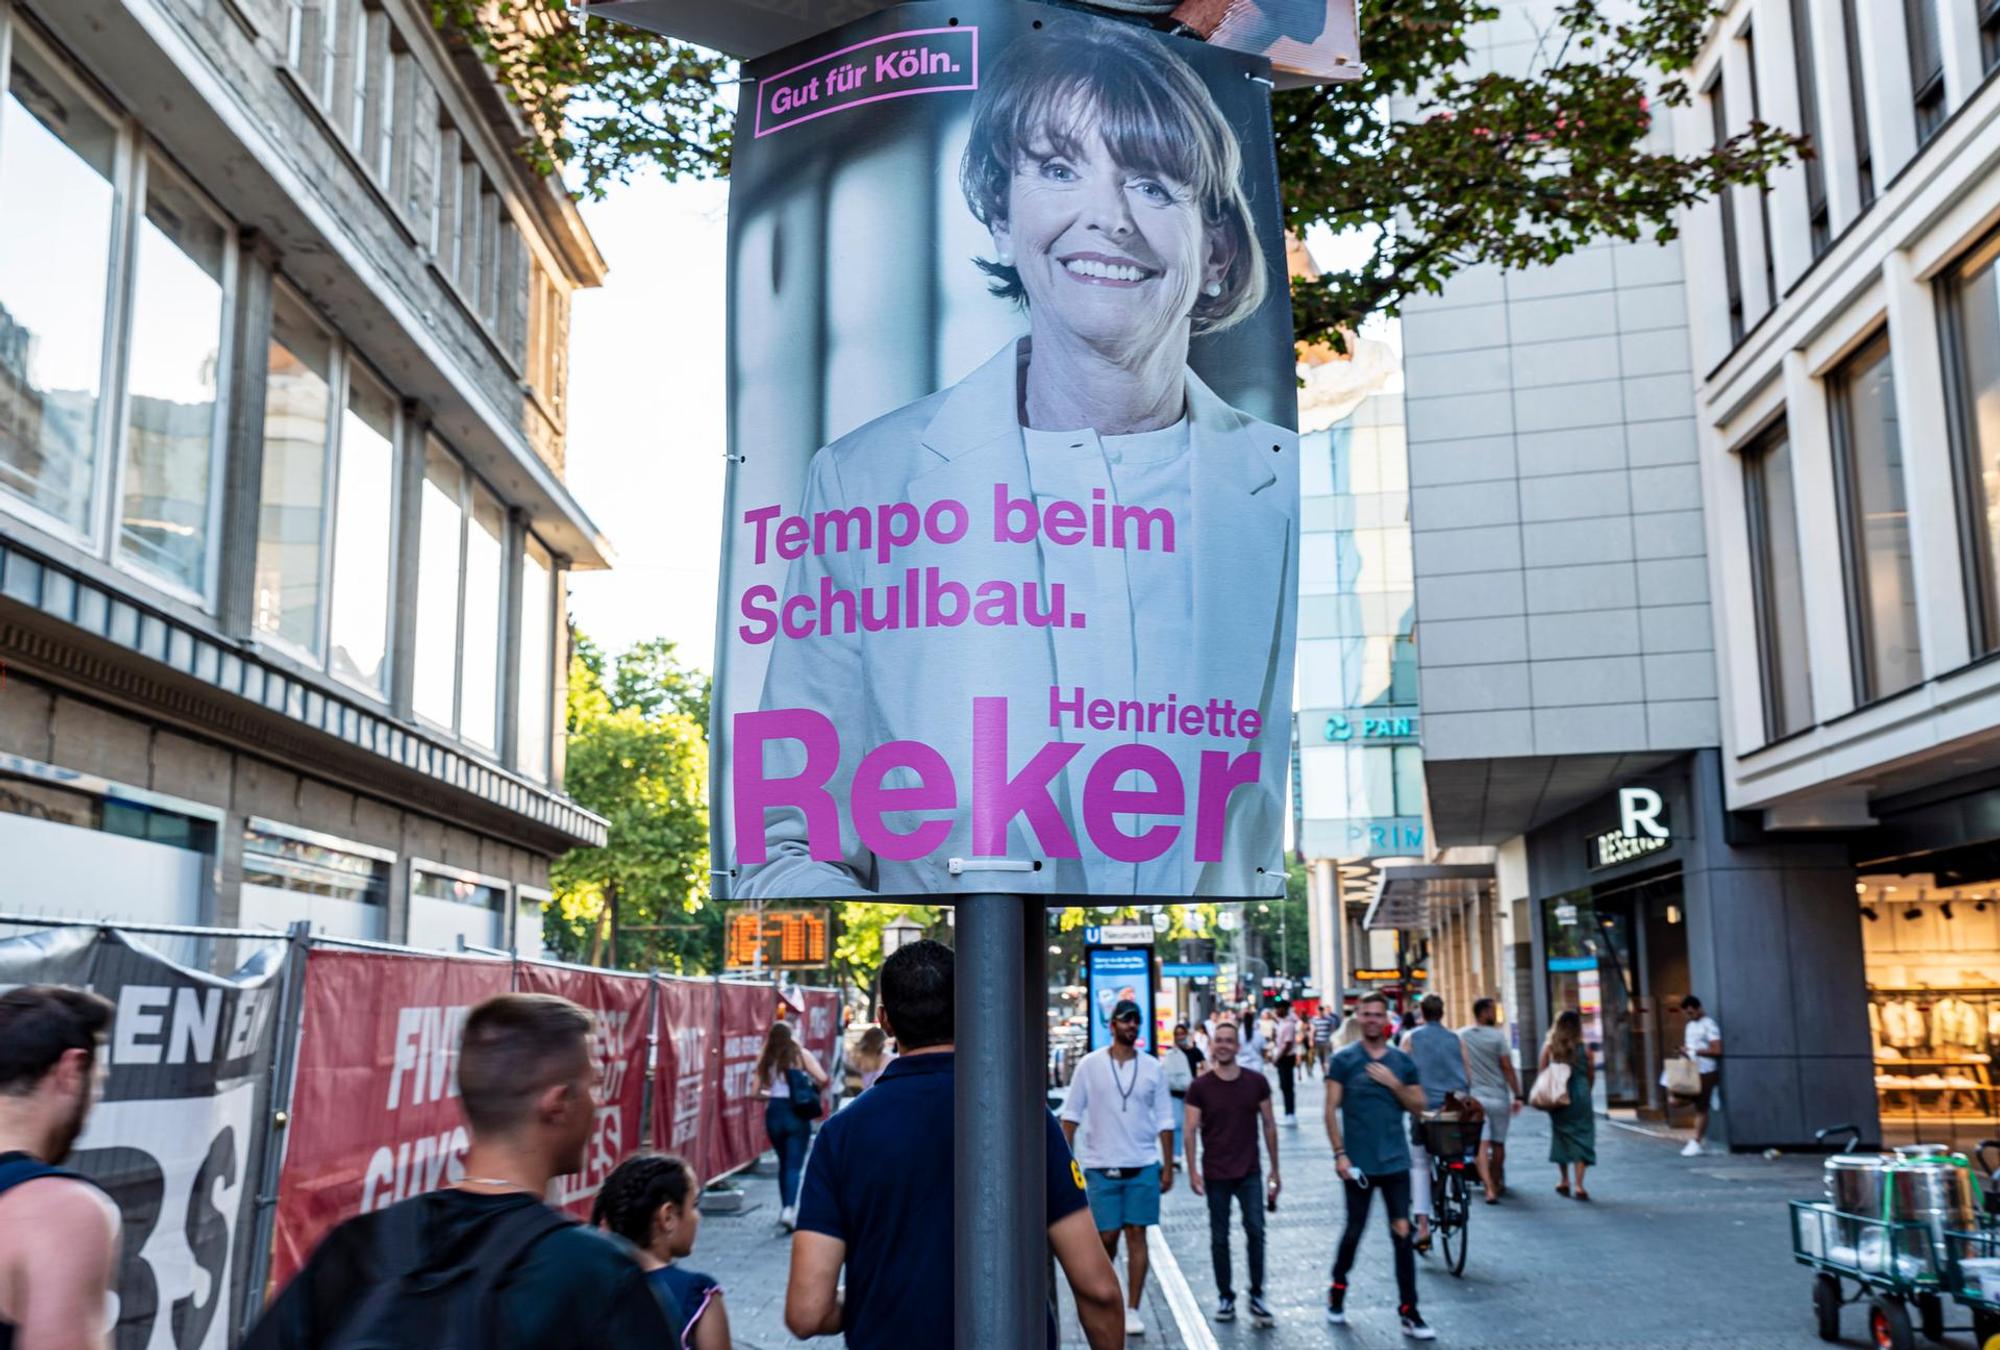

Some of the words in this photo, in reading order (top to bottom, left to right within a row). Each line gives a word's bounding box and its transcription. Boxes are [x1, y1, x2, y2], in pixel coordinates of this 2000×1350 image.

[770, 76, 819, 115] Gut
[825, 63, 868, 98] für
[875, 47, 960, 83] Köln.
[744, 500, 969, 565] Tempo
[994, 483, 1175, 554] beim
[739, 567, 1086, 645] Schulbau.
[1050, 686, 1262, 739] Henriette
[733, 697, 1261, 865] Reker
[1619, 787, 1670, 838] R
[1086, 927, 1100, 943] U
